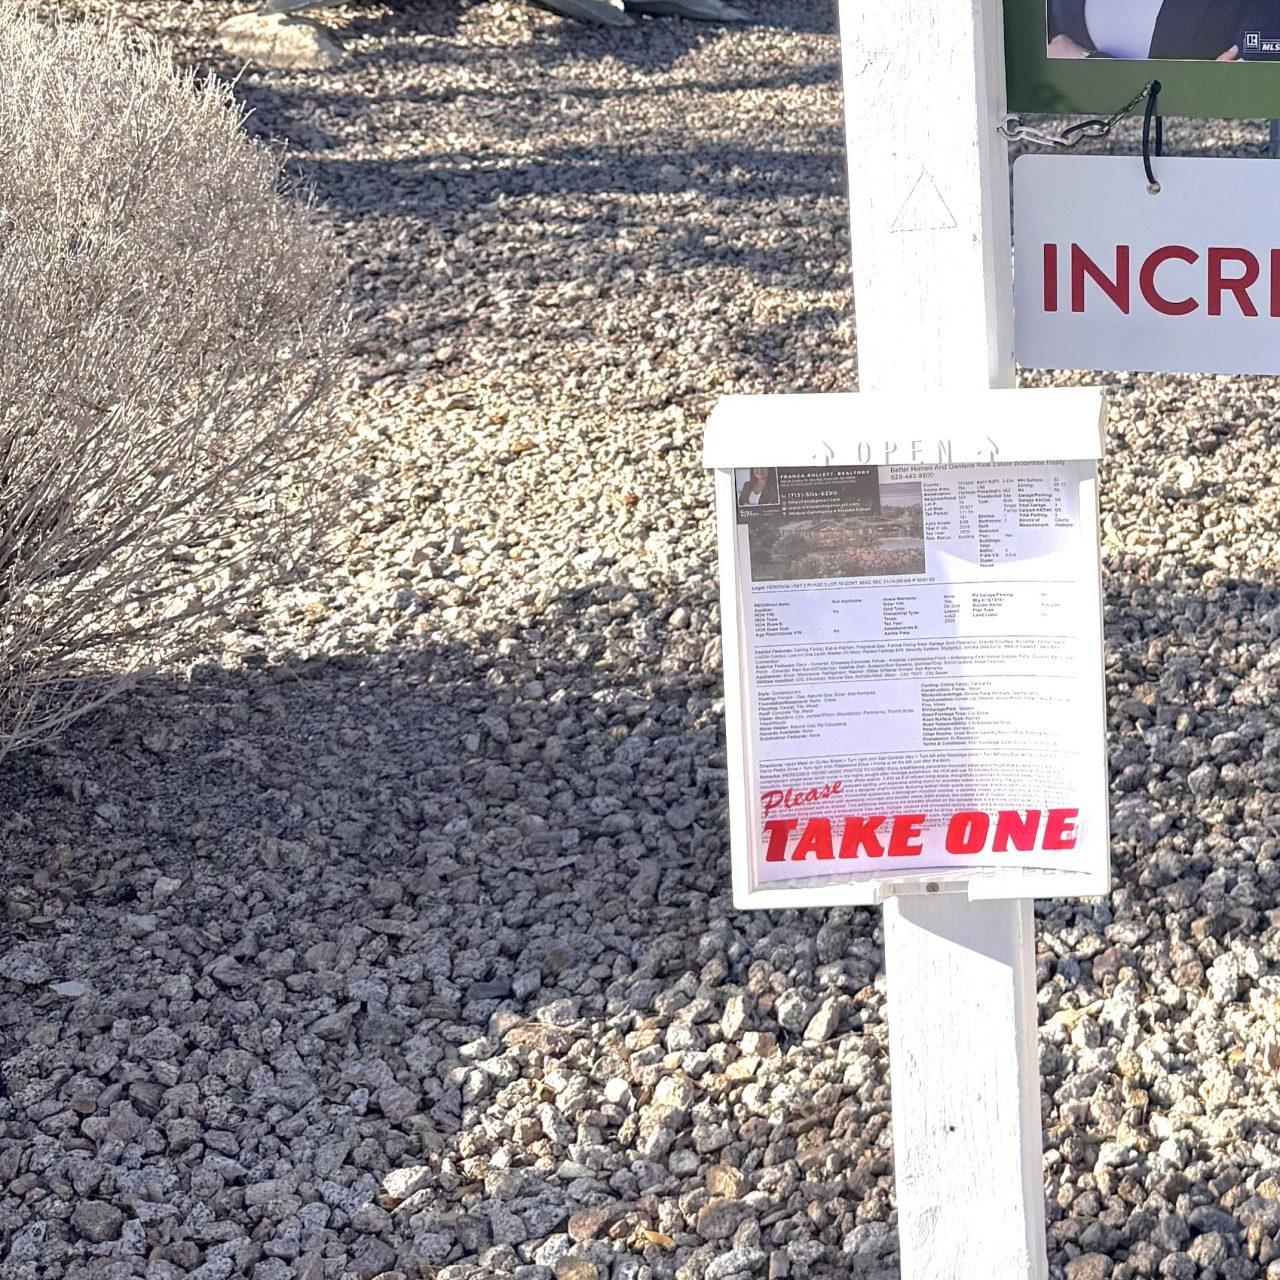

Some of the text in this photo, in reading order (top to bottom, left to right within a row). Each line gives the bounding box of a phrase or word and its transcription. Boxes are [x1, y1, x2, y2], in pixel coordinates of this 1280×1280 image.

[857, 439, 953, 465] OPEN
[761, 779, 843, 817] Please
[762, 808, 1080, 862] TAKE ONE
